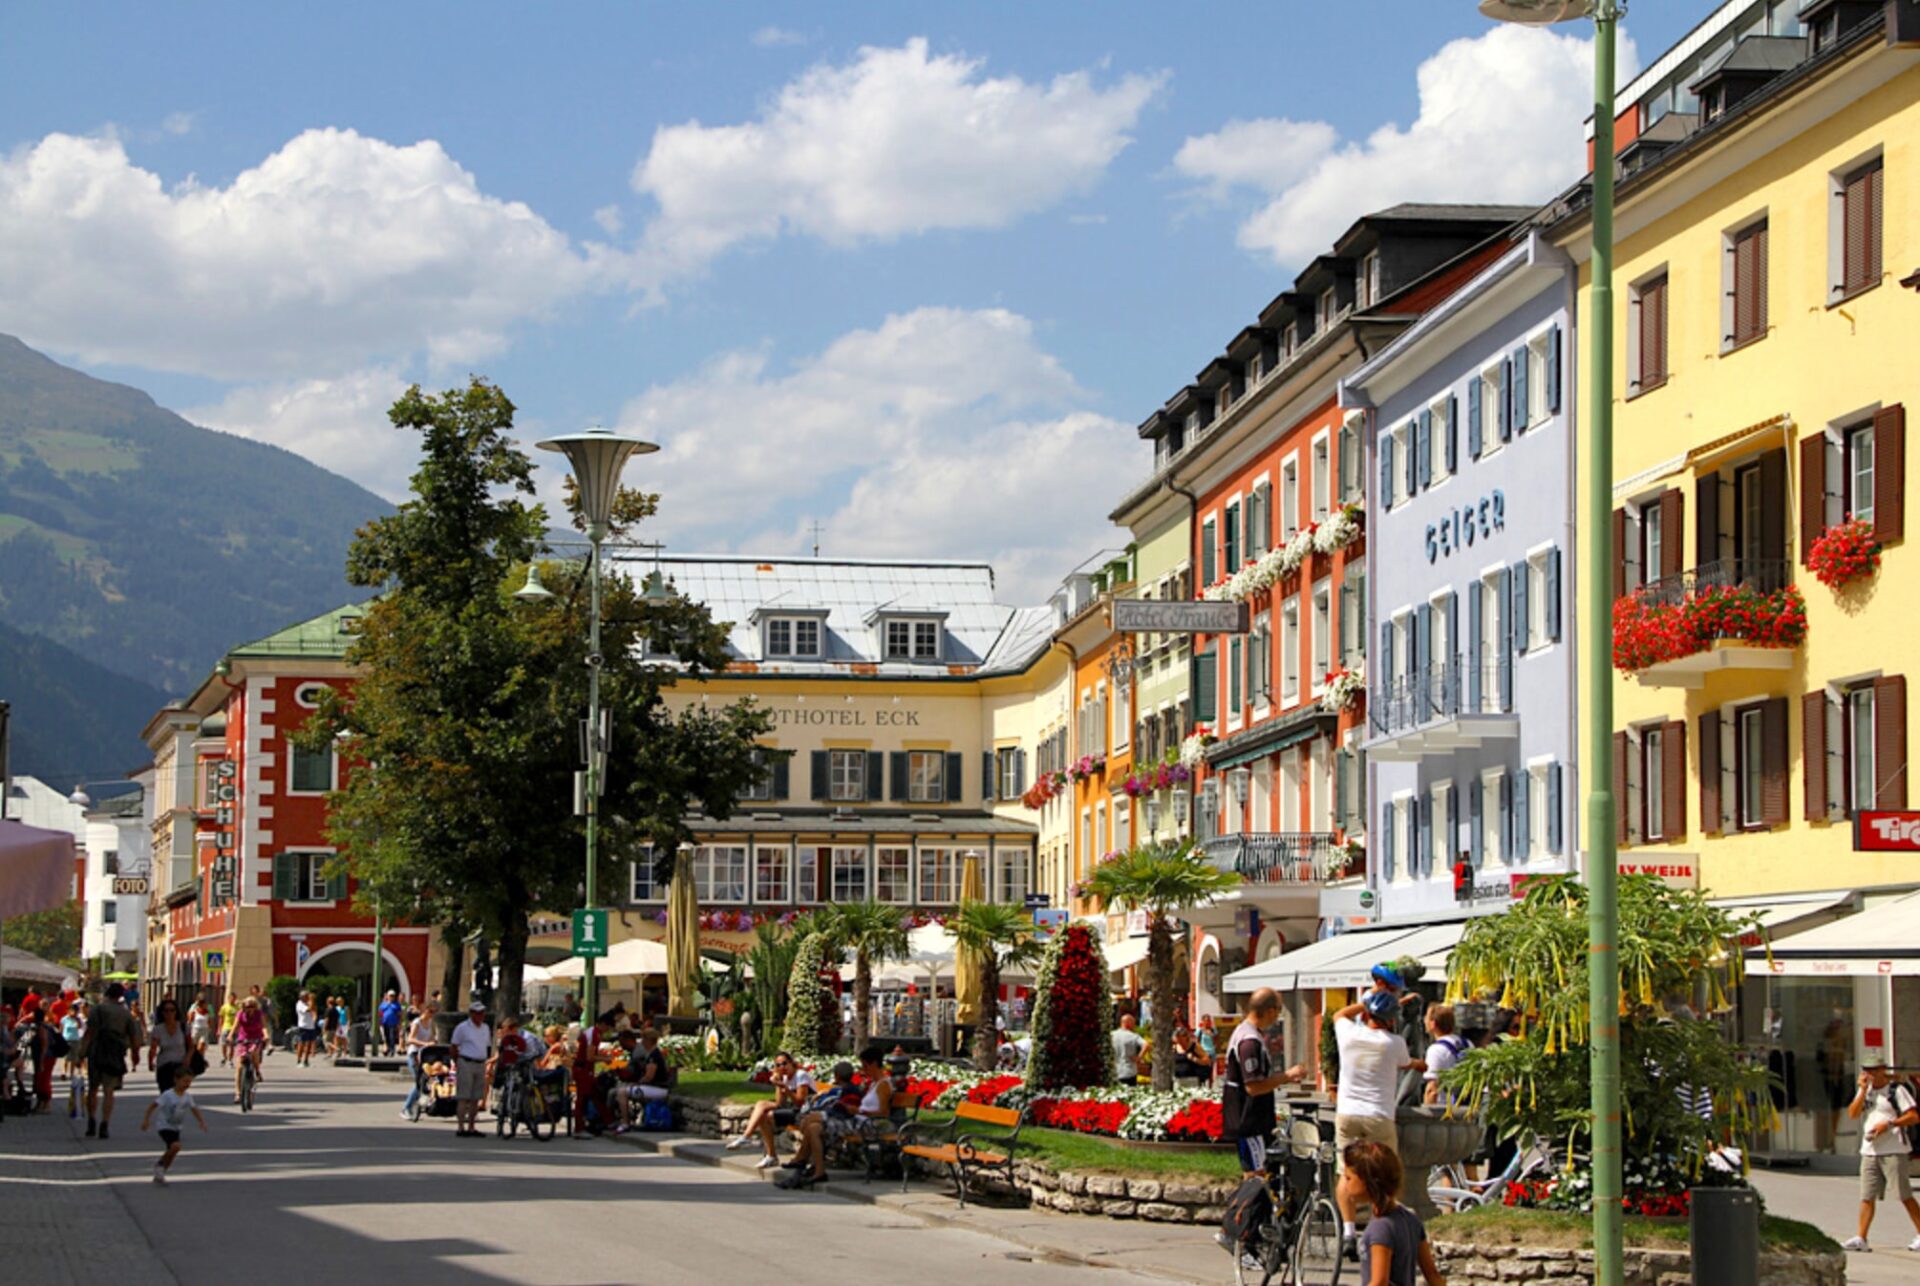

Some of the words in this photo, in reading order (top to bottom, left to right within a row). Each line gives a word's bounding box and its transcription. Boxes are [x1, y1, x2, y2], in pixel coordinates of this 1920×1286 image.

[1425, 488, 1504, 565] GEIGER
[875, 709, 919, 726] ECK
[215, 761, 234, 896] SCHUHE
[113, 879, 147, 893] FOTO
